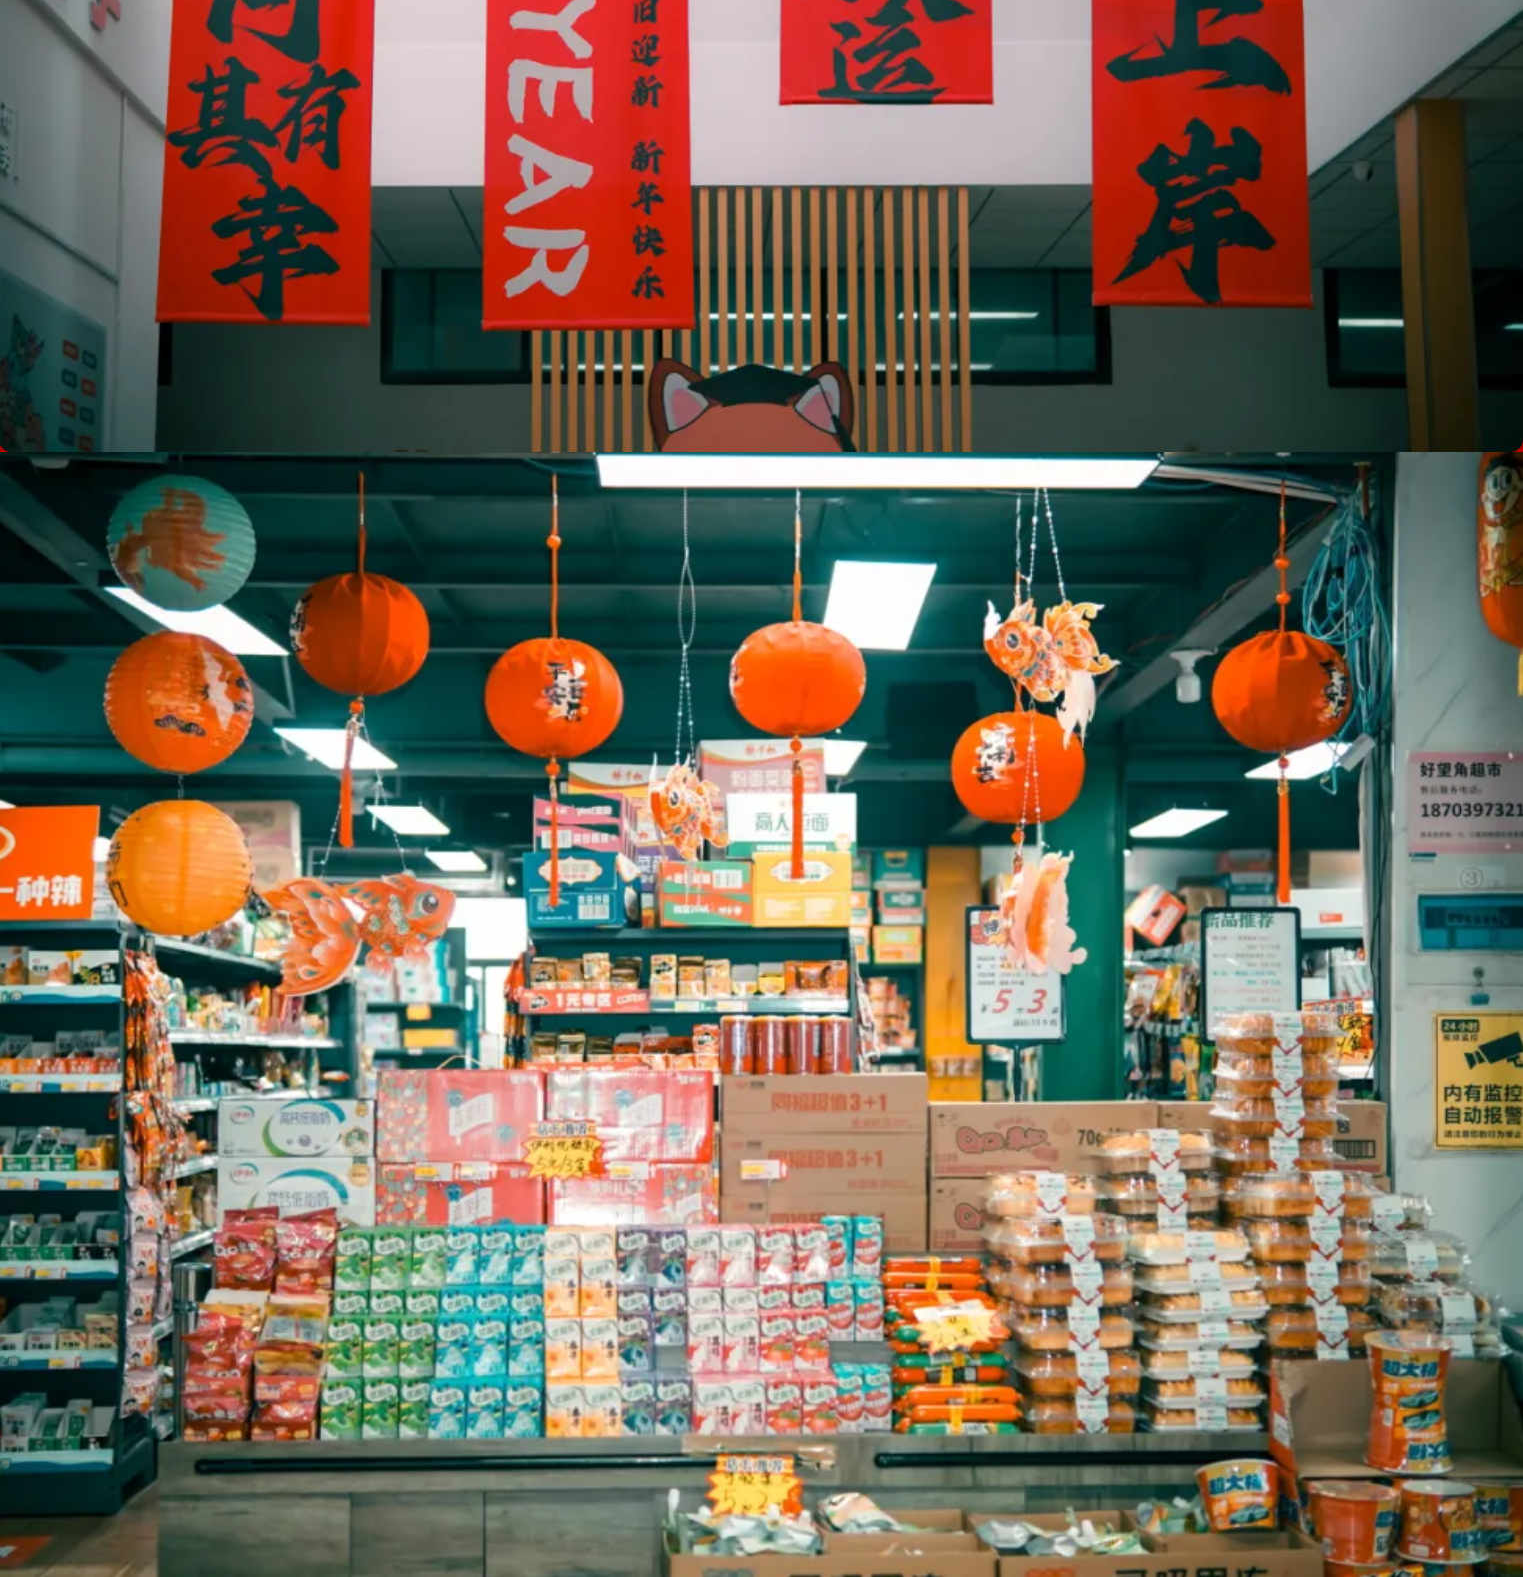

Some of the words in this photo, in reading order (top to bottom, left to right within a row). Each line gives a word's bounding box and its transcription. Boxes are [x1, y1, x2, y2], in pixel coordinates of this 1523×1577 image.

[629, 140, 668, 301] 新年快乐
[1419, 762, 1501, 778] 好望角超市
[1420, 802, 1523, 818] 1870397321
[756, 812, 829, 833] 高人面
[1443, 1084, 1523, 1103] 内有监控
[1444, 1106, 1523, 1126] 自动报警
